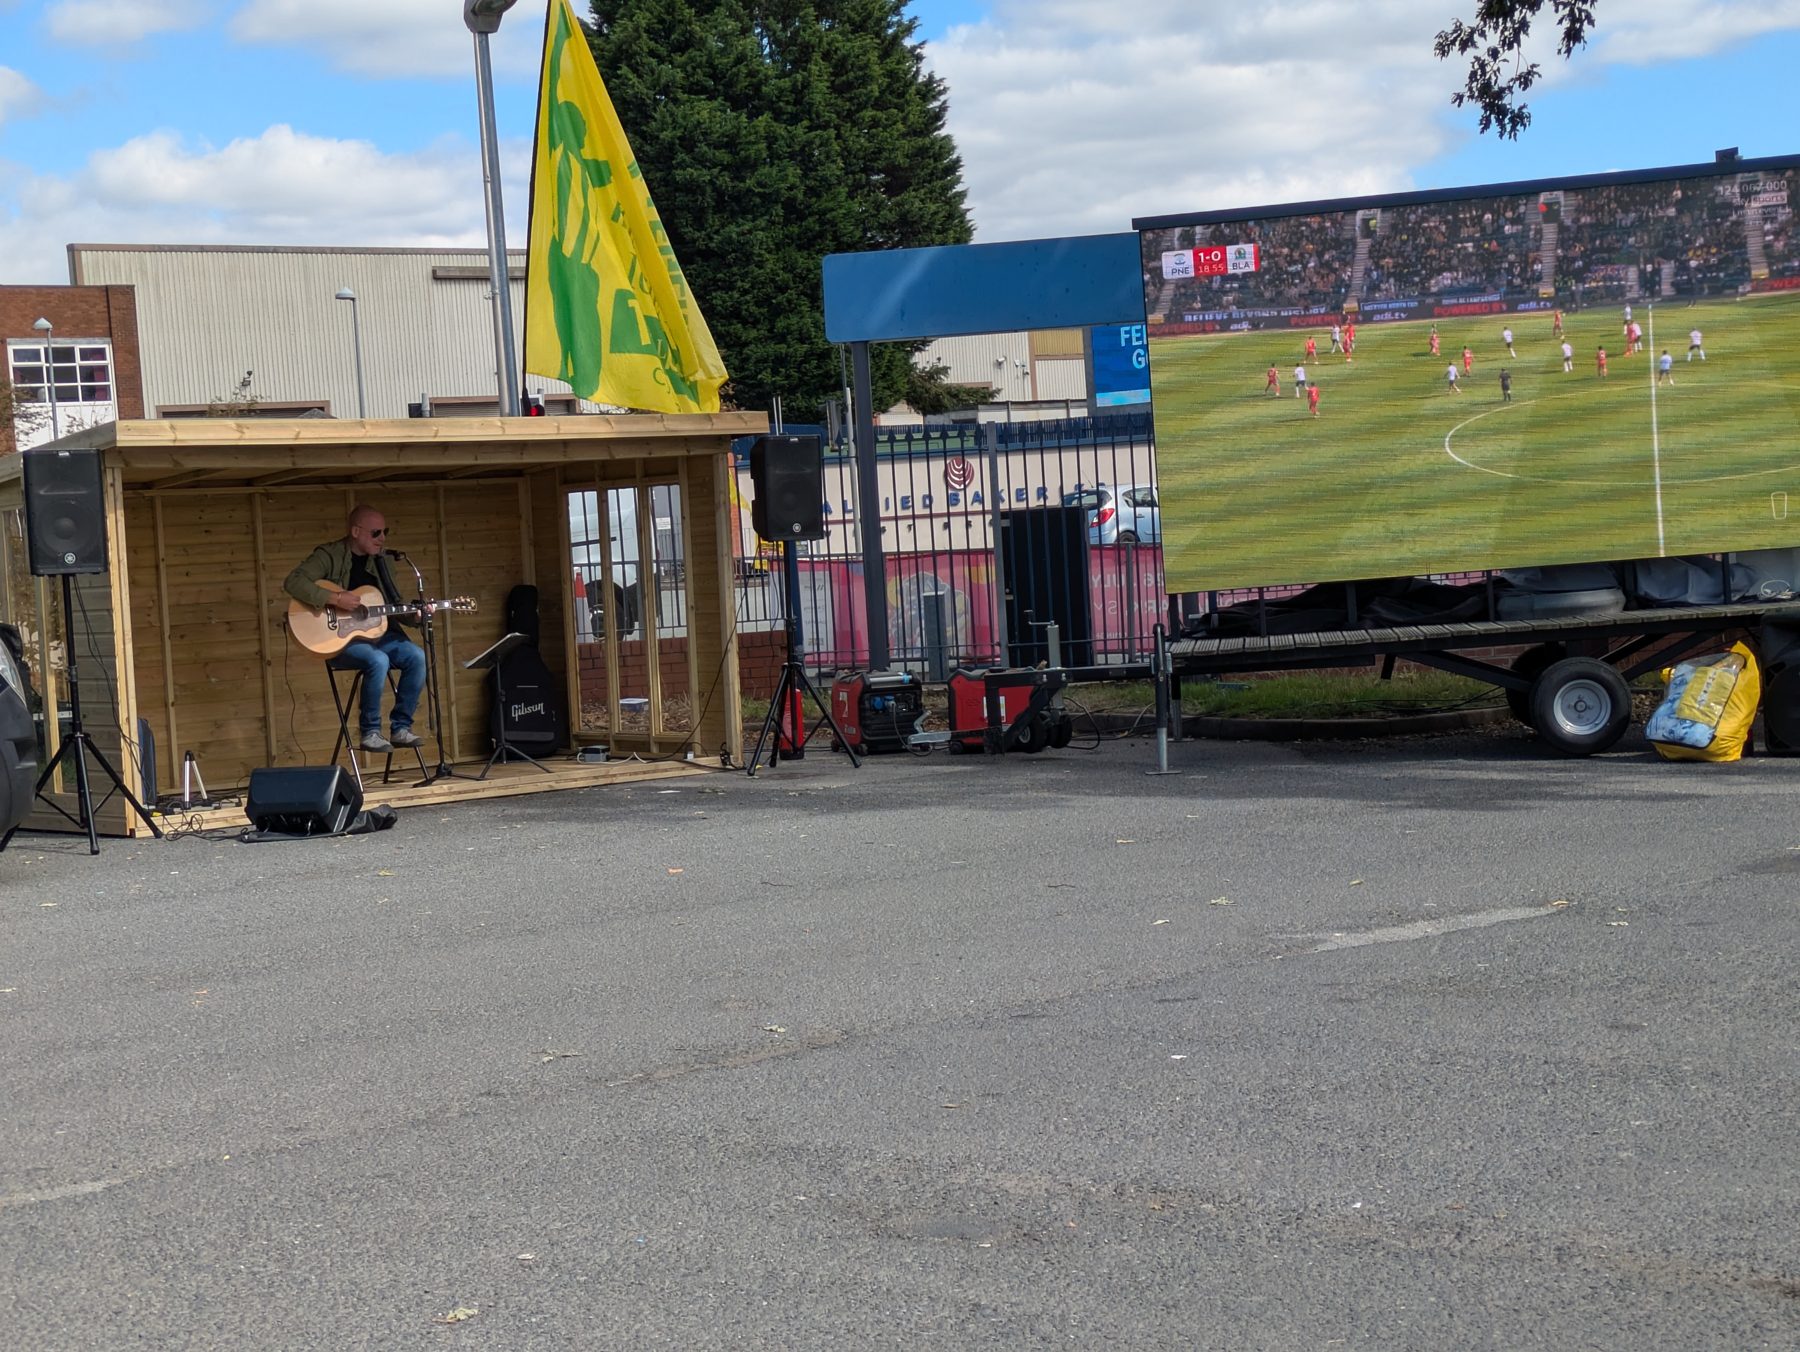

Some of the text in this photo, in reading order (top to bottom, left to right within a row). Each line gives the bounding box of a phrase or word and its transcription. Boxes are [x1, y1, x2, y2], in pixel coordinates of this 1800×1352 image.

[1171, 267, 1190, 276] PNE
[1232, 262, 1250, 270] BLA
[1132, 348, 1148, 369] G
[822, 481, 1106, 515] ALIED BAKER
[511, 702, 545, 722] Gibson
